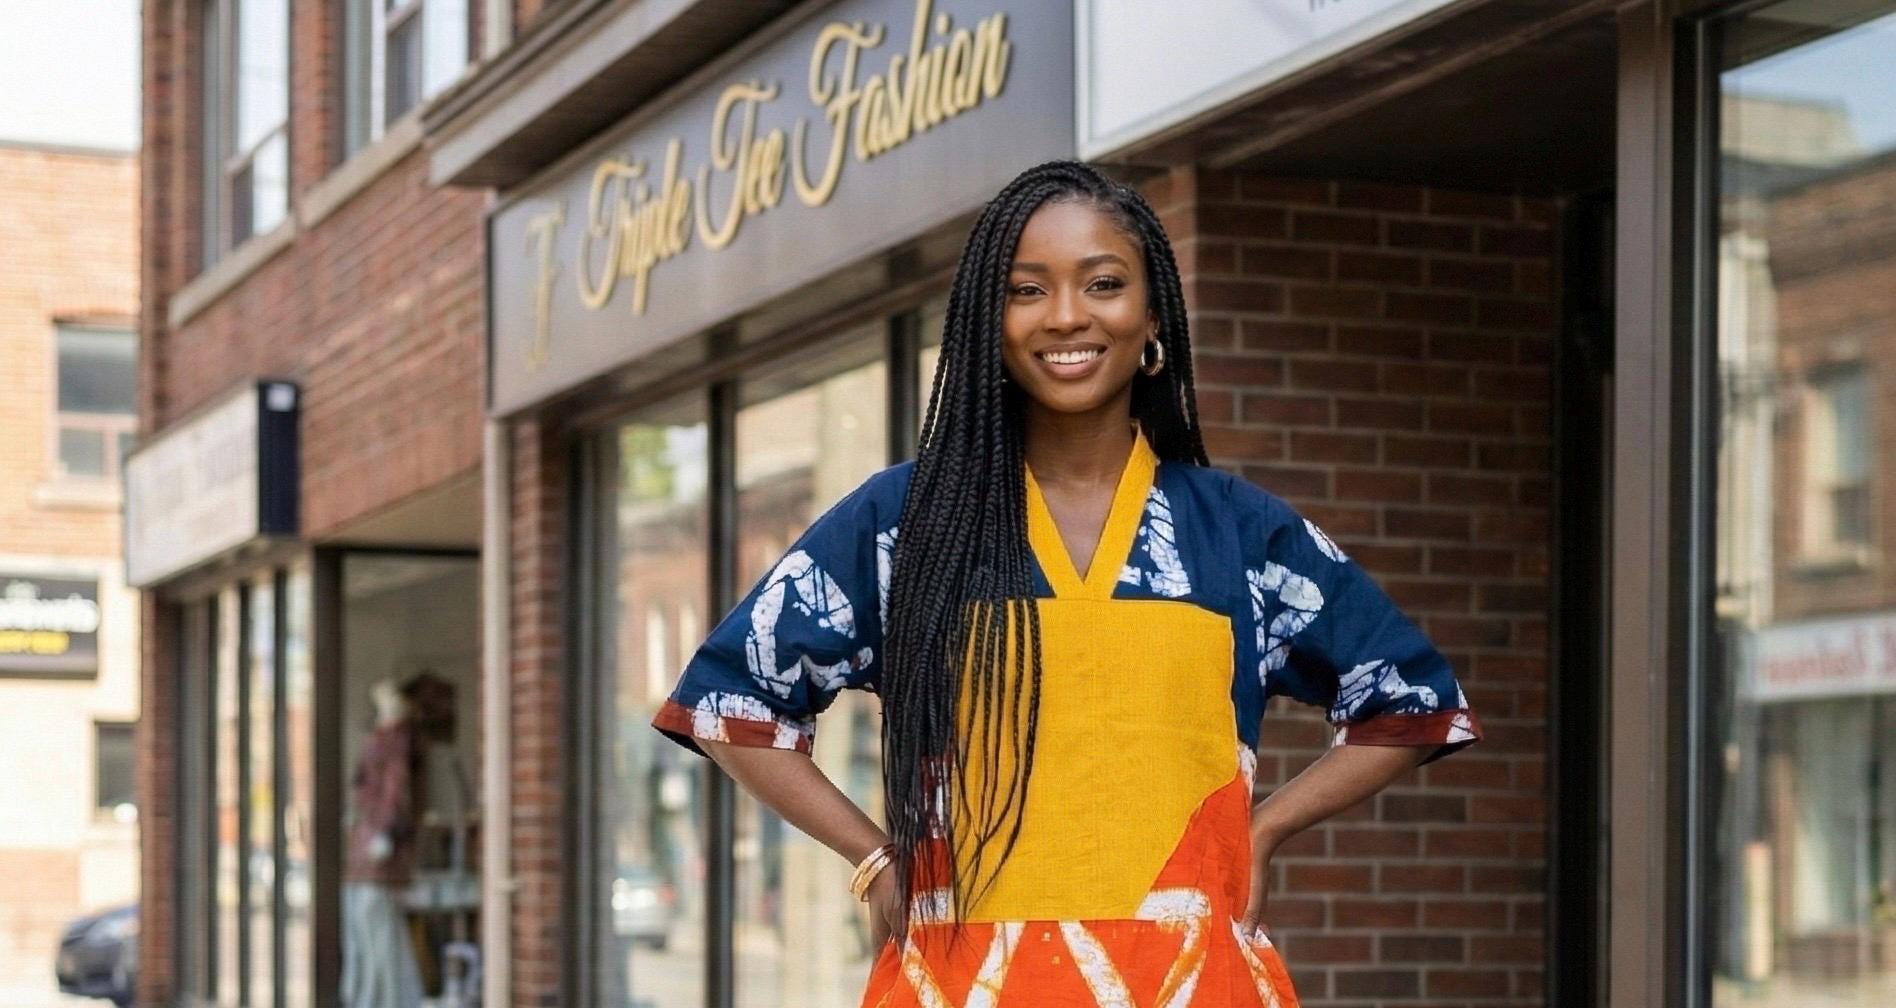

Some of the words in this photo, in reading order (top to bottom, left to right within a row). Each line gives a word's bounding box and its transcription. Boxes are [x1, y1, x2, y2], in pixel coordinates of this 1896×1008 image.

[577, 136, 693, 315] Triple
[695, 79, 786, 249] Tee
[792, 0, 1010, 207] Fashion
